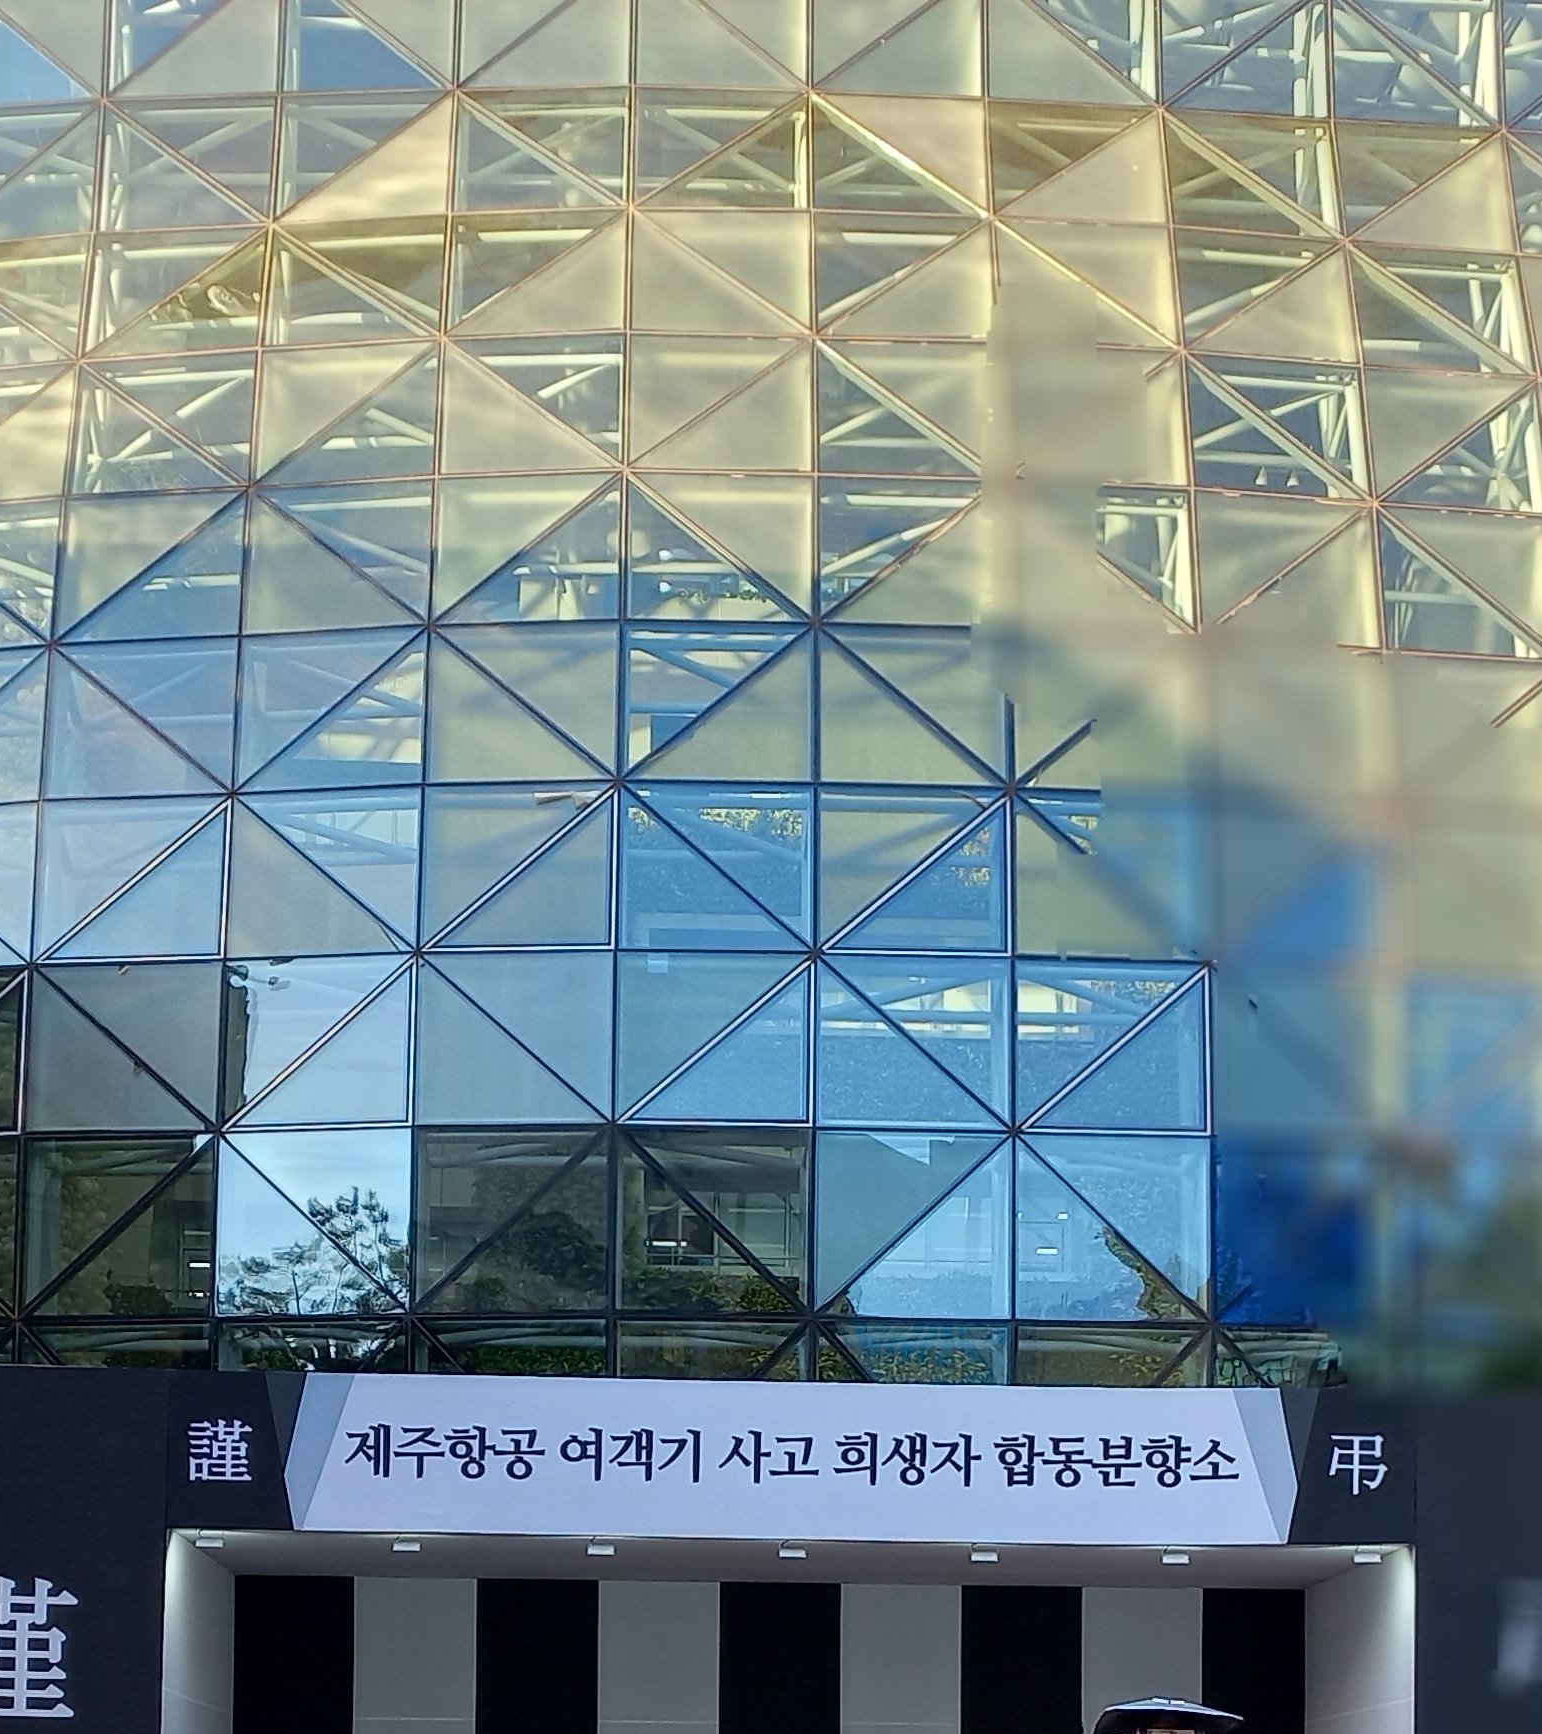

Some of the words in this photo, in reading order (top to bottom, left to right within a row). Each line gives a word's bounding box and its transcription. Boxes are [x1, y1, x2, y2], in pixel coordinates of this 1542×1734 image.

[186, 1418, 253, 1482] 謹
[344, 1423, 545, 1480] 제주항공
[559, 1426, 702, 1484] 여객기
[718, 1429, 819, 1484] 사고
[832, 1431, 982, 1487] 희생자
[992, 1433, 1241, 1489] 합동분향소
[1327, 1432, 1389, 1496] 弔
